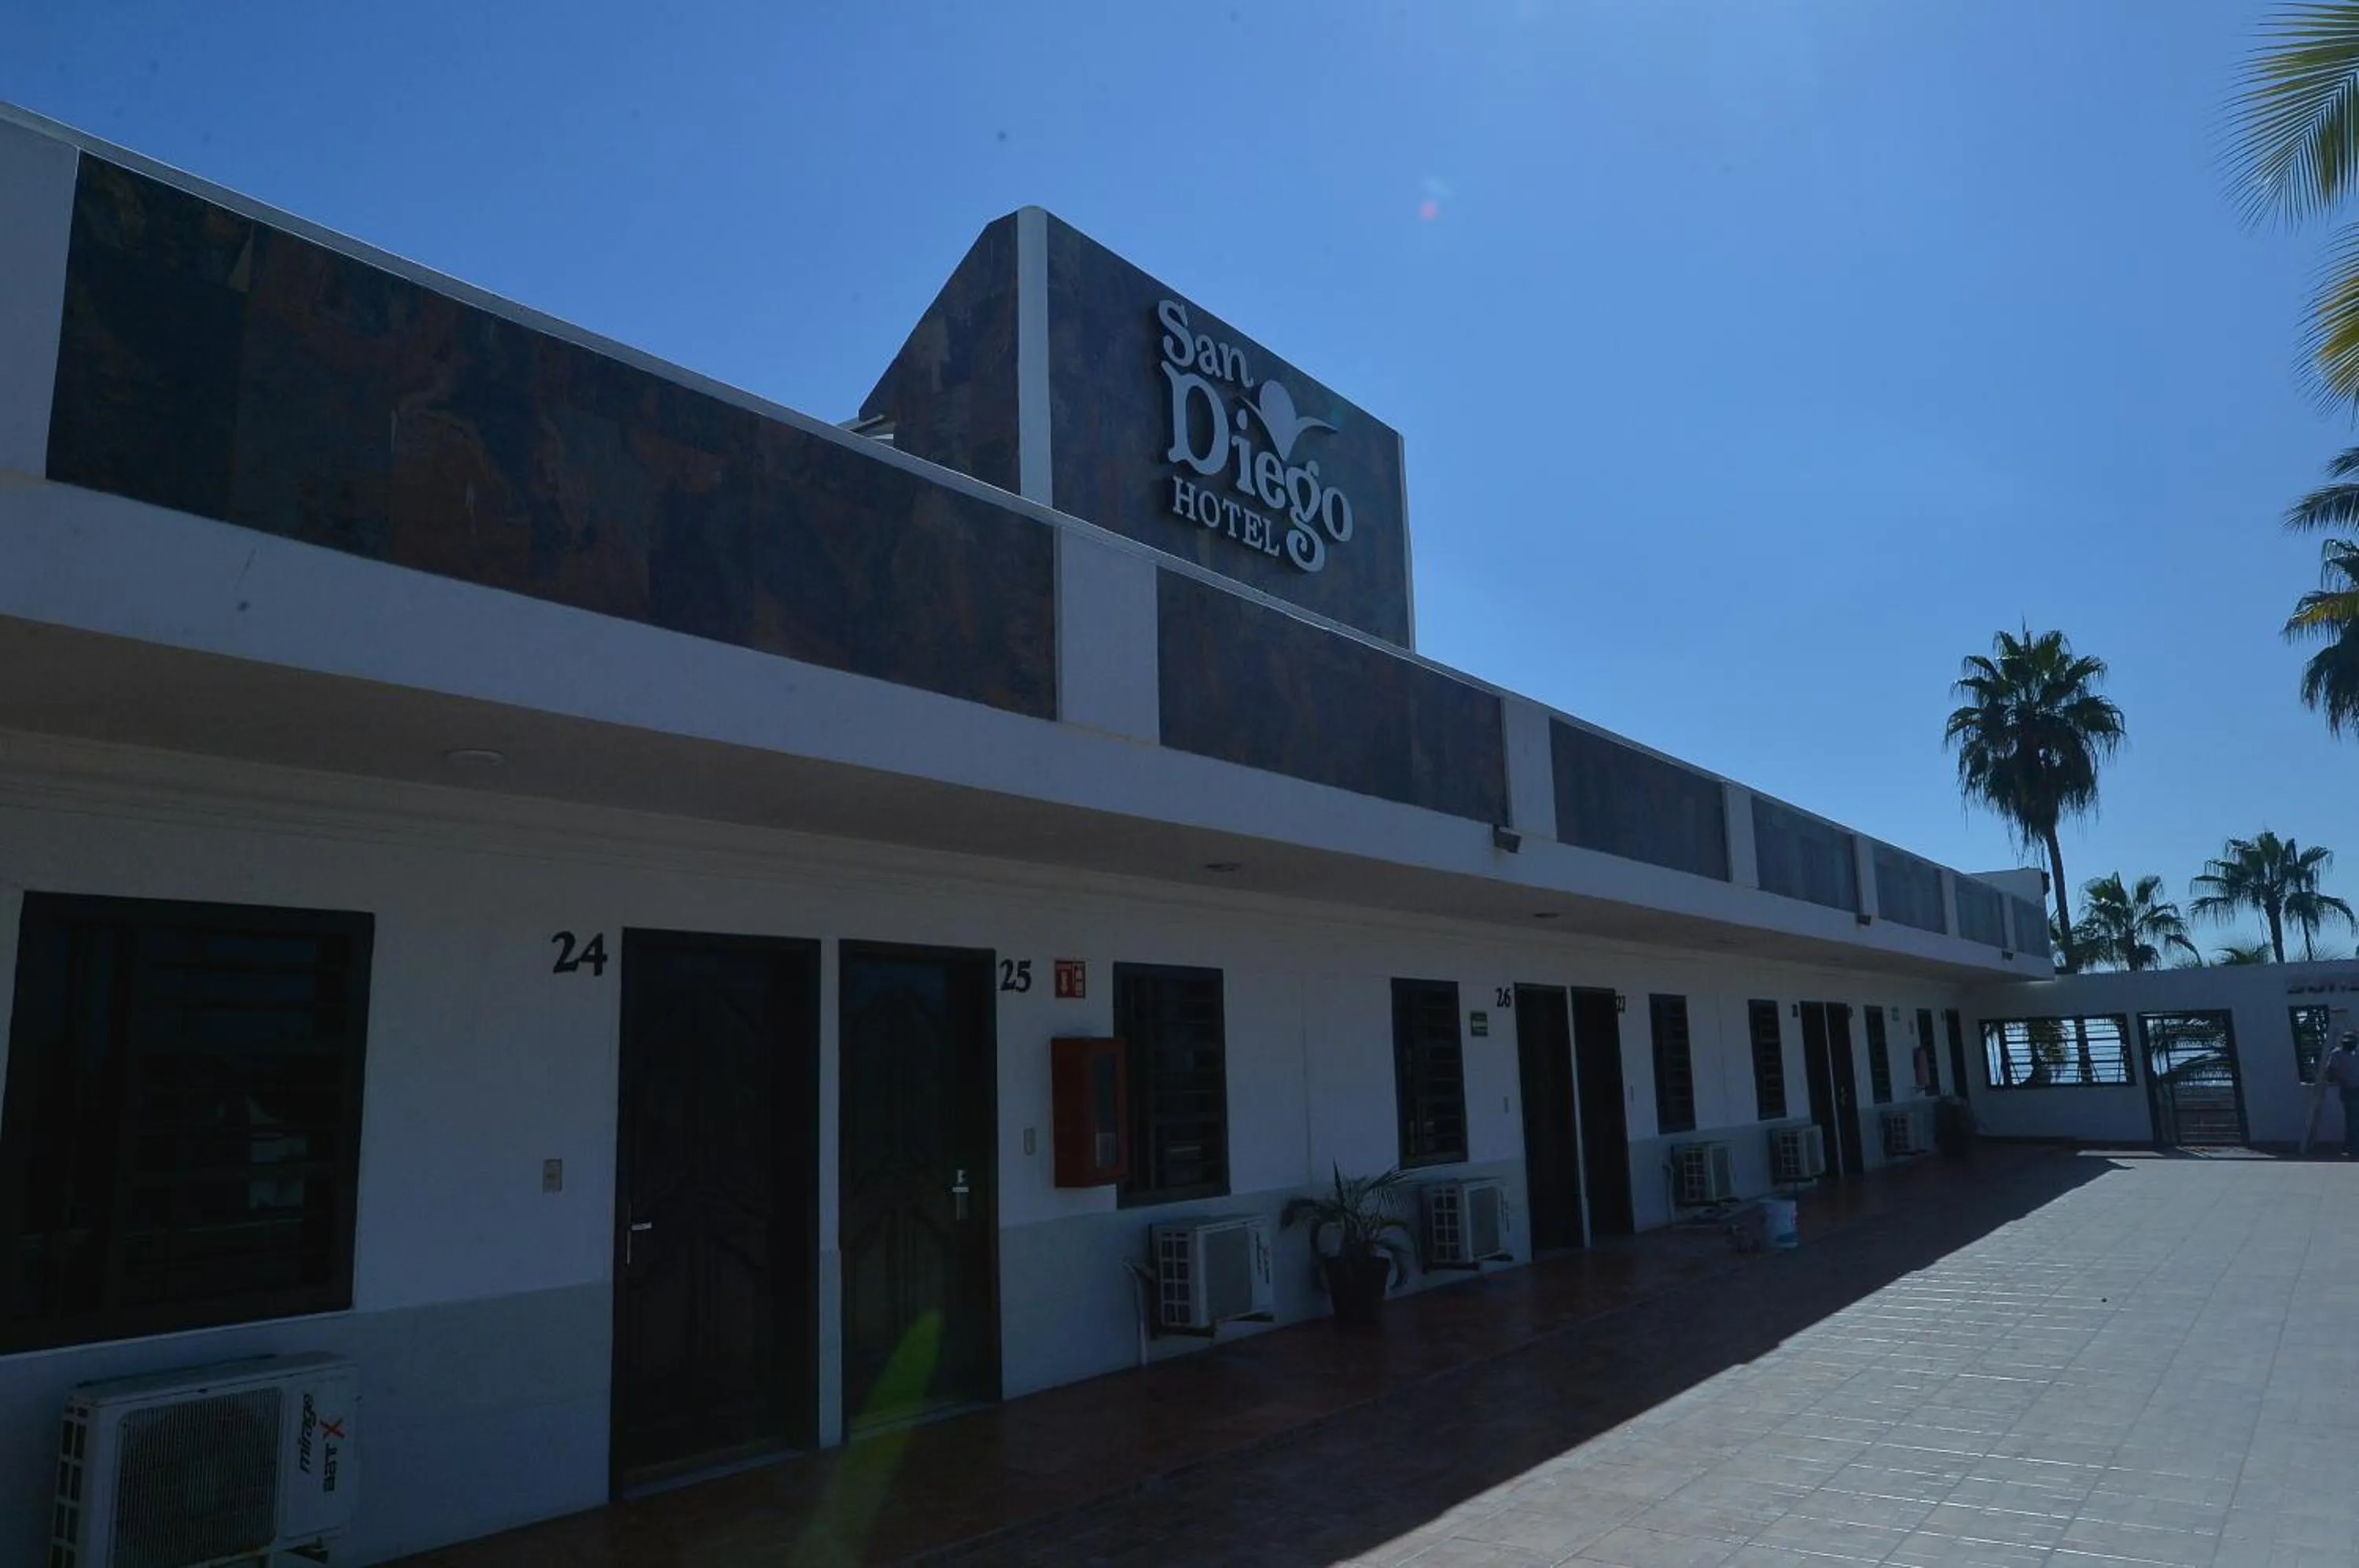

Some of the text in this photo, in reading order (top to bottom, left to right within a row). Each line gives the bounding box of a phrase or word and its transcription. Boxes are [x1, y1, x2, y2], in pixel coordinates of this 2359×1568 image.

[1157, 300, 1254, 388] San
[1161, 359, 1353, 572] Diego
[1172, 475, 1280, 557] HOTEL
[552, 931, 608, 976] 24
[999, 959, 1032, 992] 25
[1496, 987, 1511, 1007] 26
[298, 1393, 316, 1474] mirage
